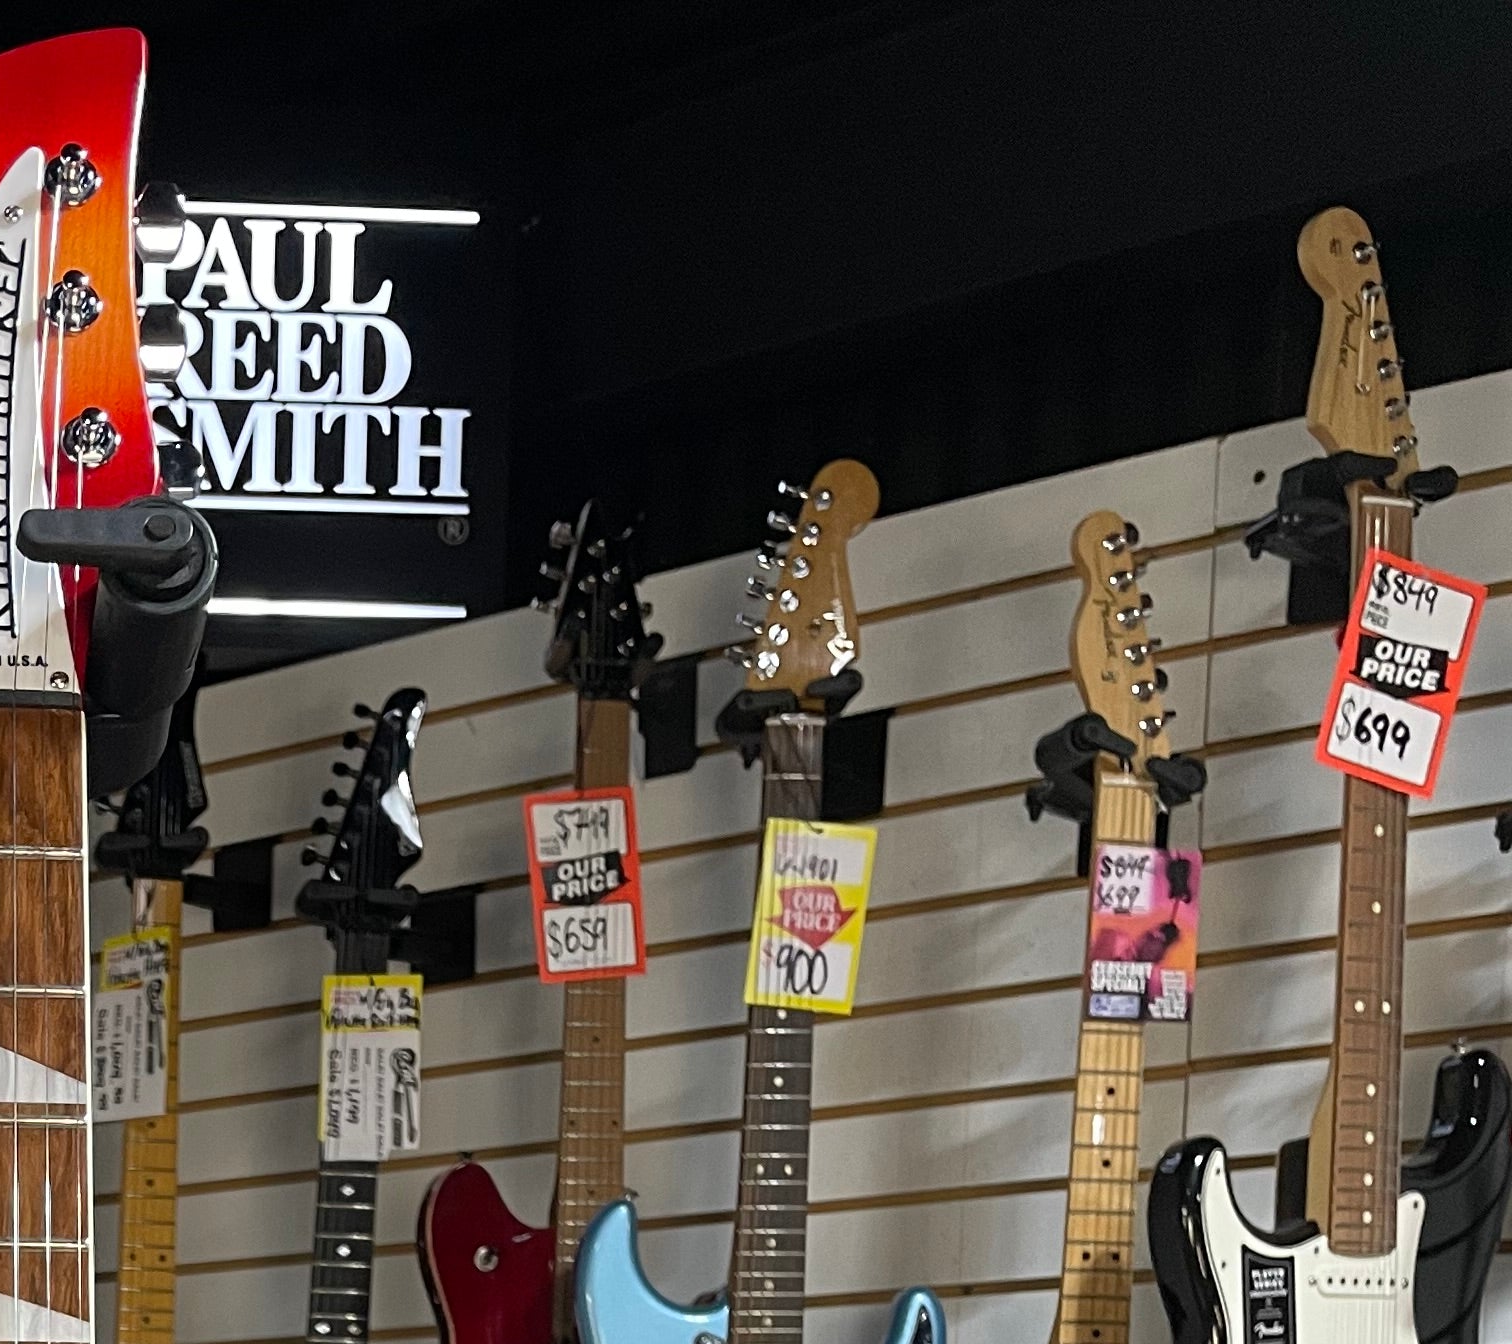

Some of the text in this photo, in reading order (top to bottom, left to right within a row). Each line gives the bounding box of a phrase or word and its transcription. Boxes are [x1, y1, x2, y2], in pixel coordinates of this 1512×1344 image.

[138, 217, 393, 314] PAUL
[1374, 640, 1432, 669] OUR
[1359, 656, 1441, 692] PRICE
[1335, 695, 1411, 761] $699
[551, 868, 621, 903] PRICE
[556, 855, 608, 881] OUR
